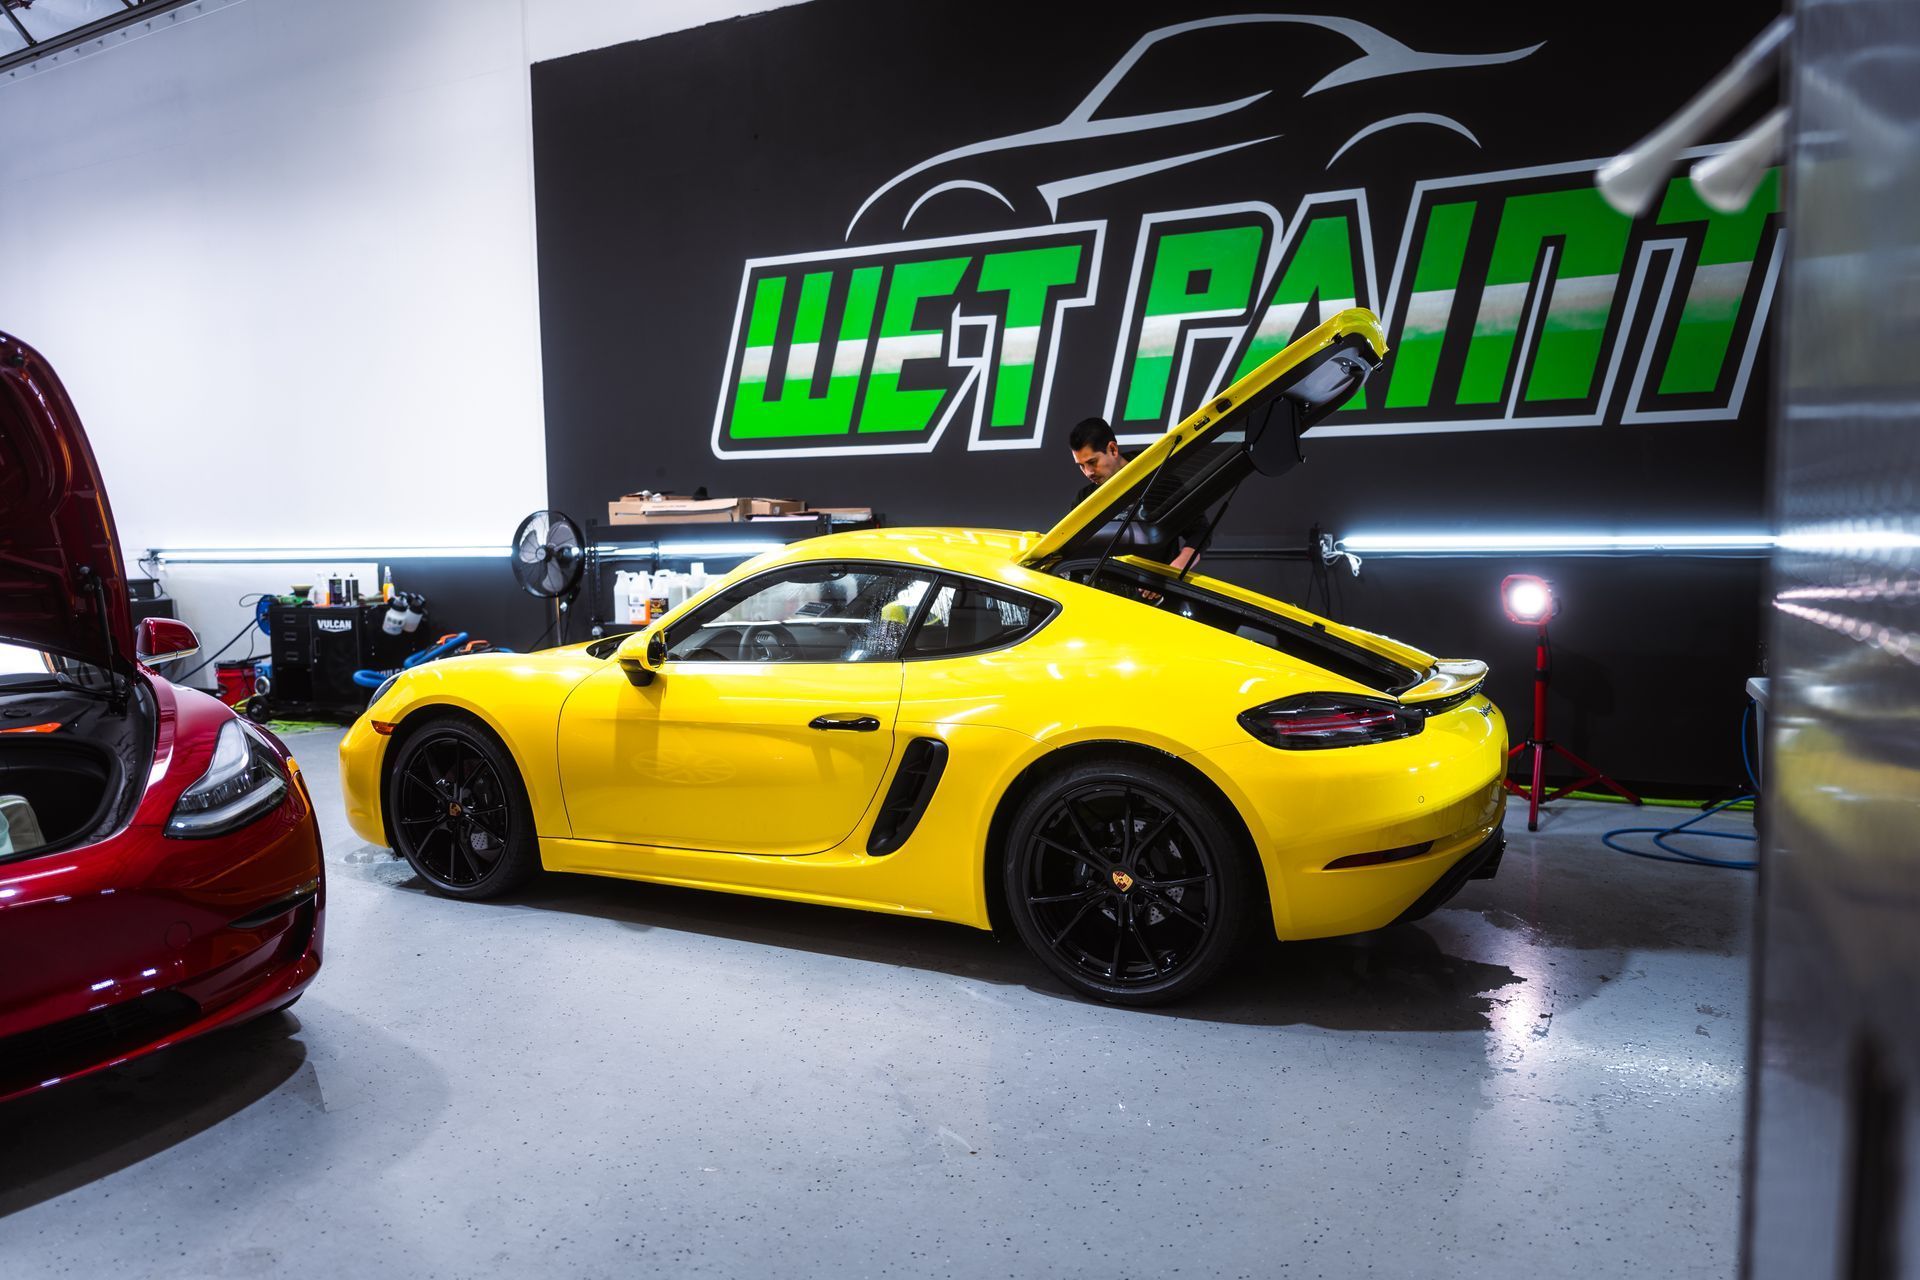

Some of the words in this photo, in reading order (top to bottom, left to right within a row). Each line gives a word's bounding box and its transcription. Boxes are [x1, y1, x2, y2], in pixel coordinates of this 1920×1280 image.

[727, 242, 1085, 441] WET
[1121, 165, 1783, 424] PAINT
[317, 619, 352, 630] VULCAN
